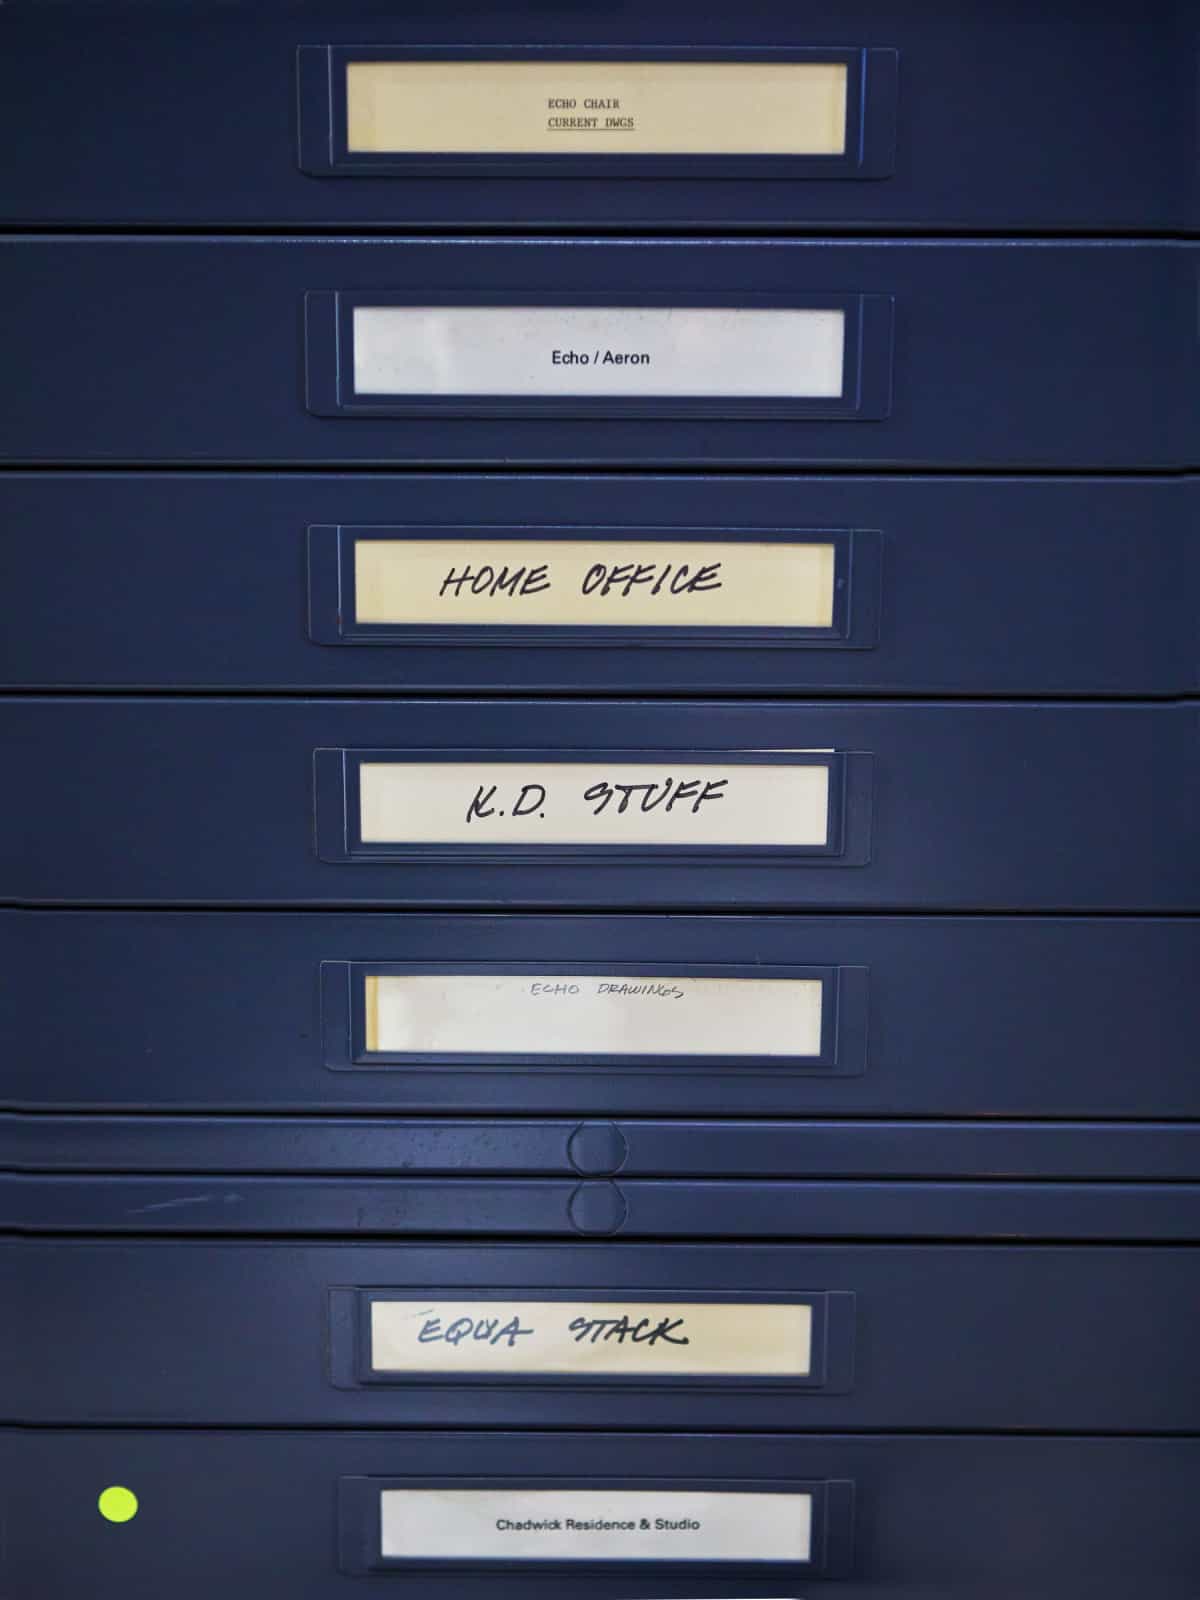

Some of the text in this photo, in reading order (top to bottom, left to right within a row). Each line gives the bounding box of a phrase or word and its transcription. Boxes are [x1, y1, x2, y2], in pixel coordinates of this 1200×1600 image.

[548, 98, 620, 110] ECHO CHAIR
[547, 117, 635, 129] CURRENT DWGS
[551, 349, 650, 365] Echo / Aeron
[439, 562, 723, 597] HOME OFFICE
[466, 777, 729, 824] K.D. STUFF
[530, 982, 684, 999] ECHO DRAWINGS
[417, 1315, 690, 1347] EQUA STACK
[495, 1517, 701, 1531] Chadwick Residence & Studio
